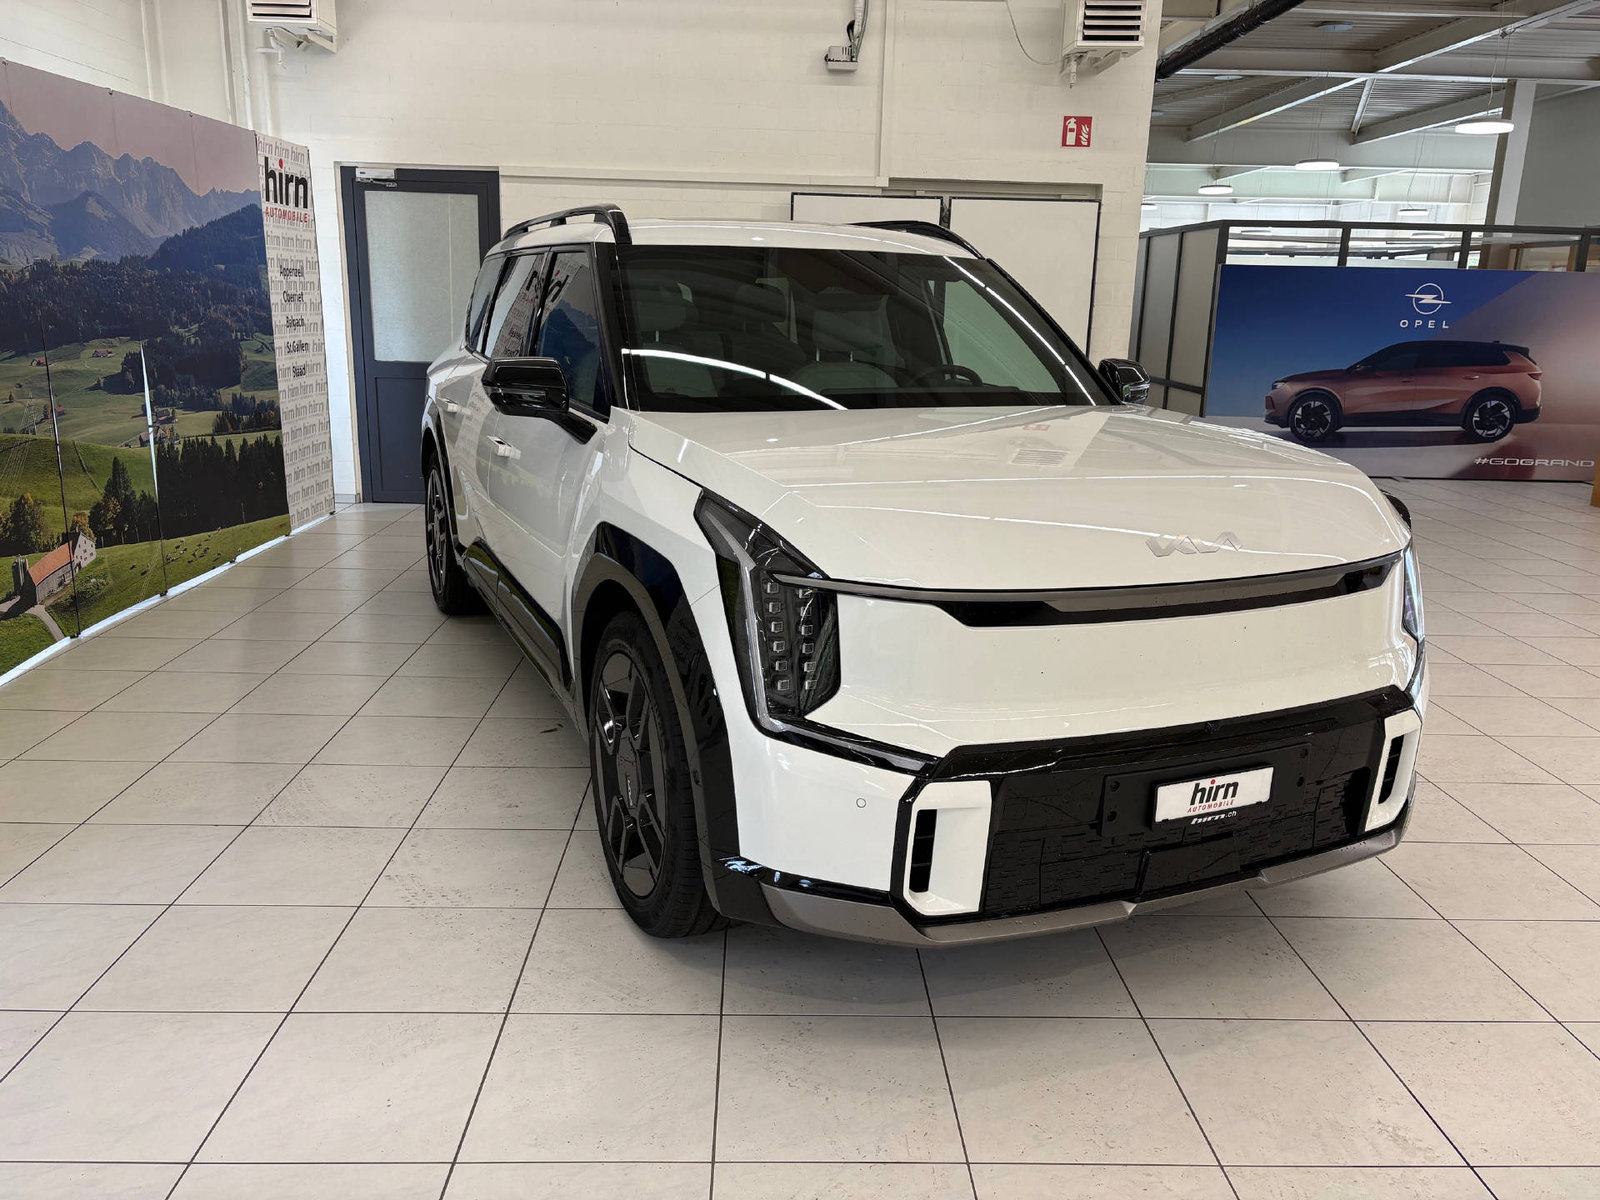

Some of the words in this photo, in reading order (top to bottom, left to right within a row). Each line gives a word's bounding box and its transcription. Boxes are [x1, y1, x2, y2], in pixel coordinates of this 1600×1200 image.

[258, 136, 273, 153] hirn
[274, 140, 290, 158] hirn
[291, 146, 305, 164] hirn
[264, 156, 308, 209] hirn
[265, 206, 308, 223] AUTOMOBILE
[280, 264, 305, 280] Appenzell
[286, 315, 305, 330] Balgach
[1399, 319, 1449, 329] OPEL
[292, 363, 306, 378] Staad
[1474, 457, 1595, 467] #GOGRAND
[1189, 778, 1239, 806] hirn
[1186, 799, 1235, 814] AUTOMOBILE
[1190, 810, 1237, 825] hirn.ch
